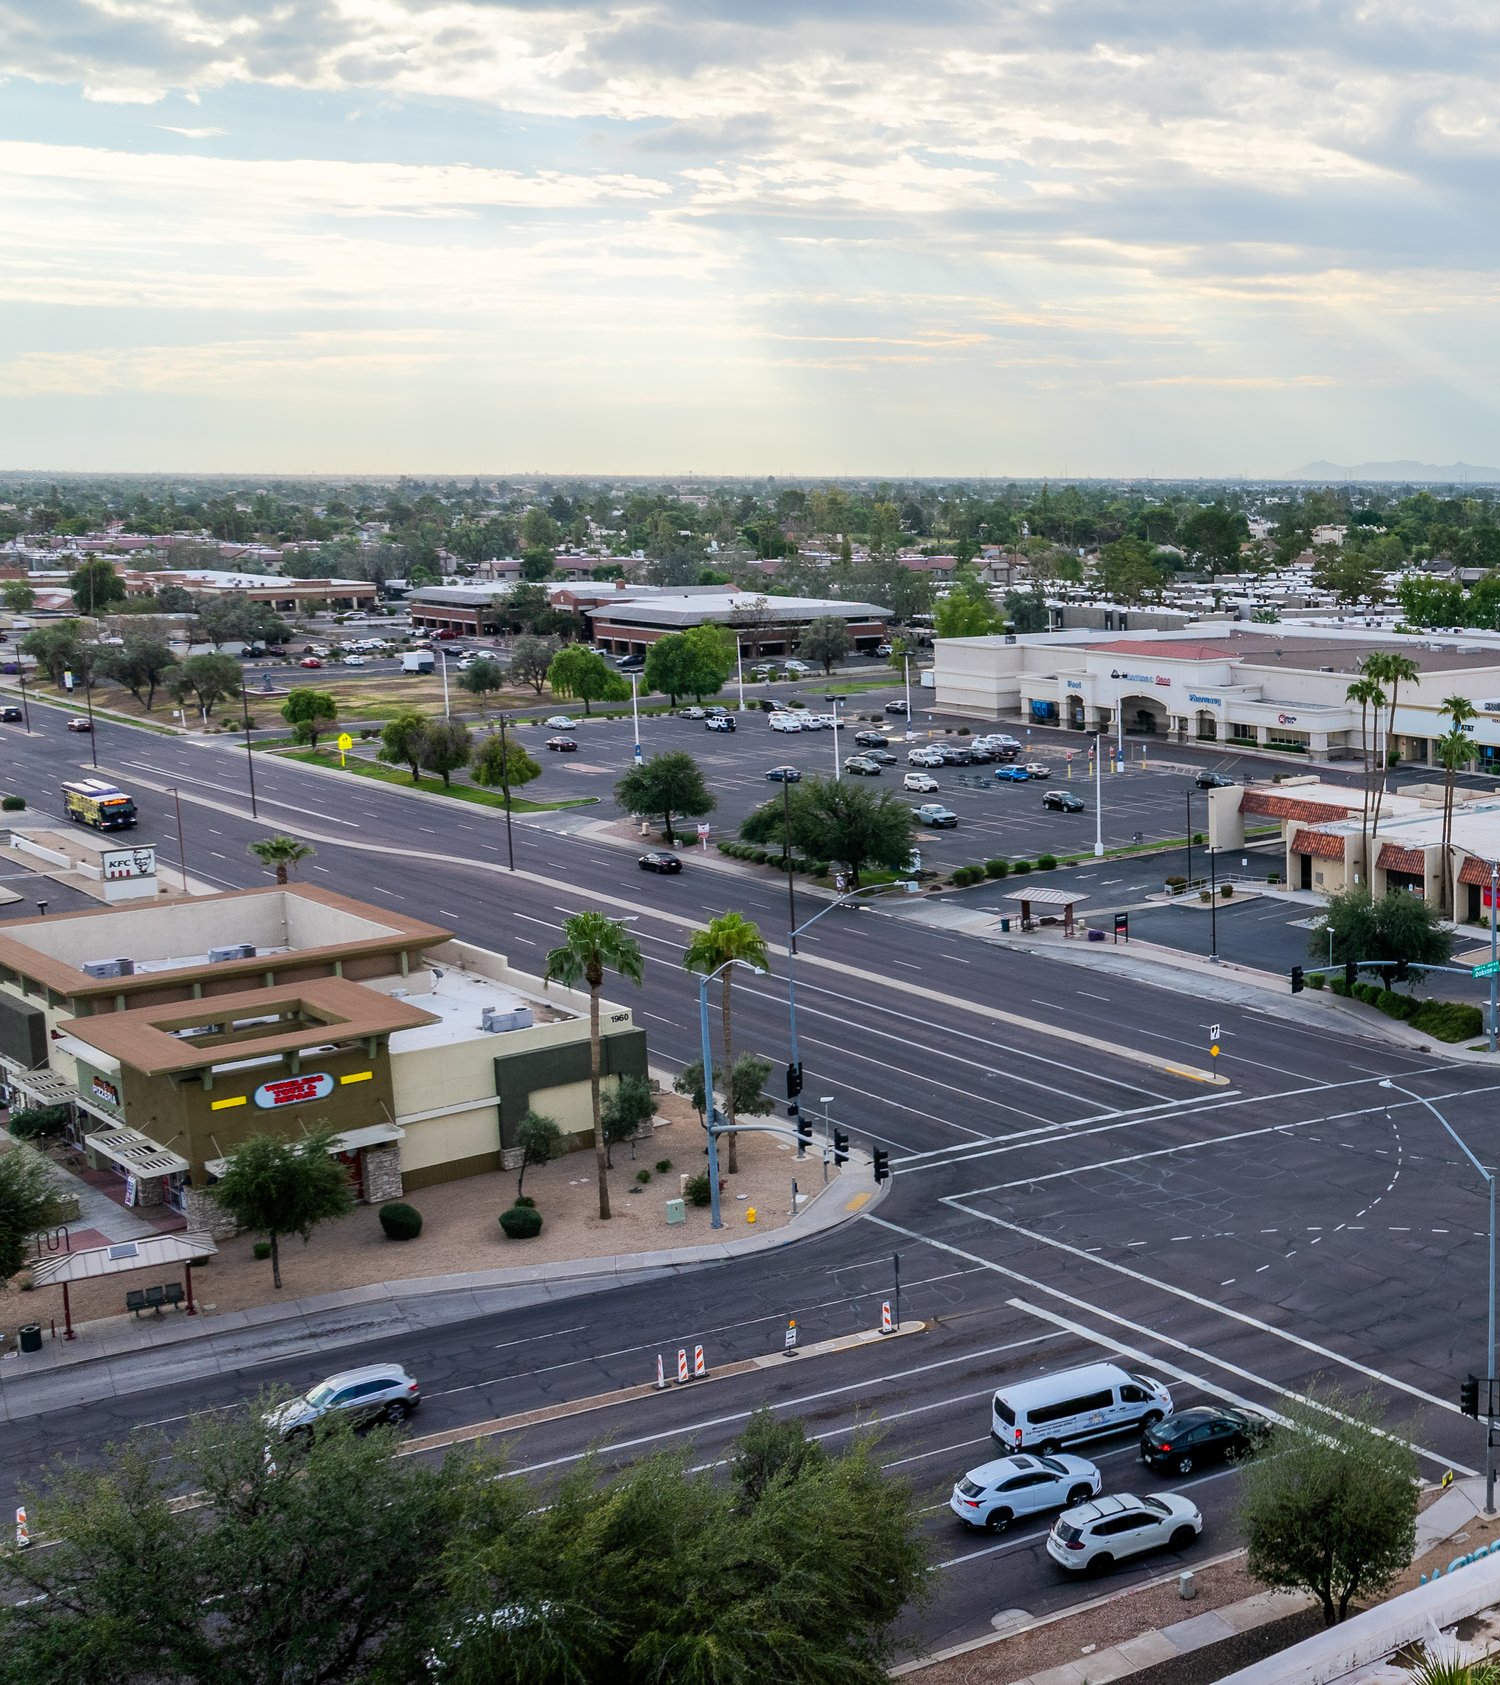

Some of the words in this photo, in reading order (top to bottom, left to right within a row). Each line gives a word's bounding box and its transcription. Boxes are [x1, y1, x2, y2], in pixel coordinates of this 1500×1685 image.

[109, 860, 130, 868] KFC
[1475, 968, 1492, 978] Dobson
[611, 1013, 629, 1023] 1960
